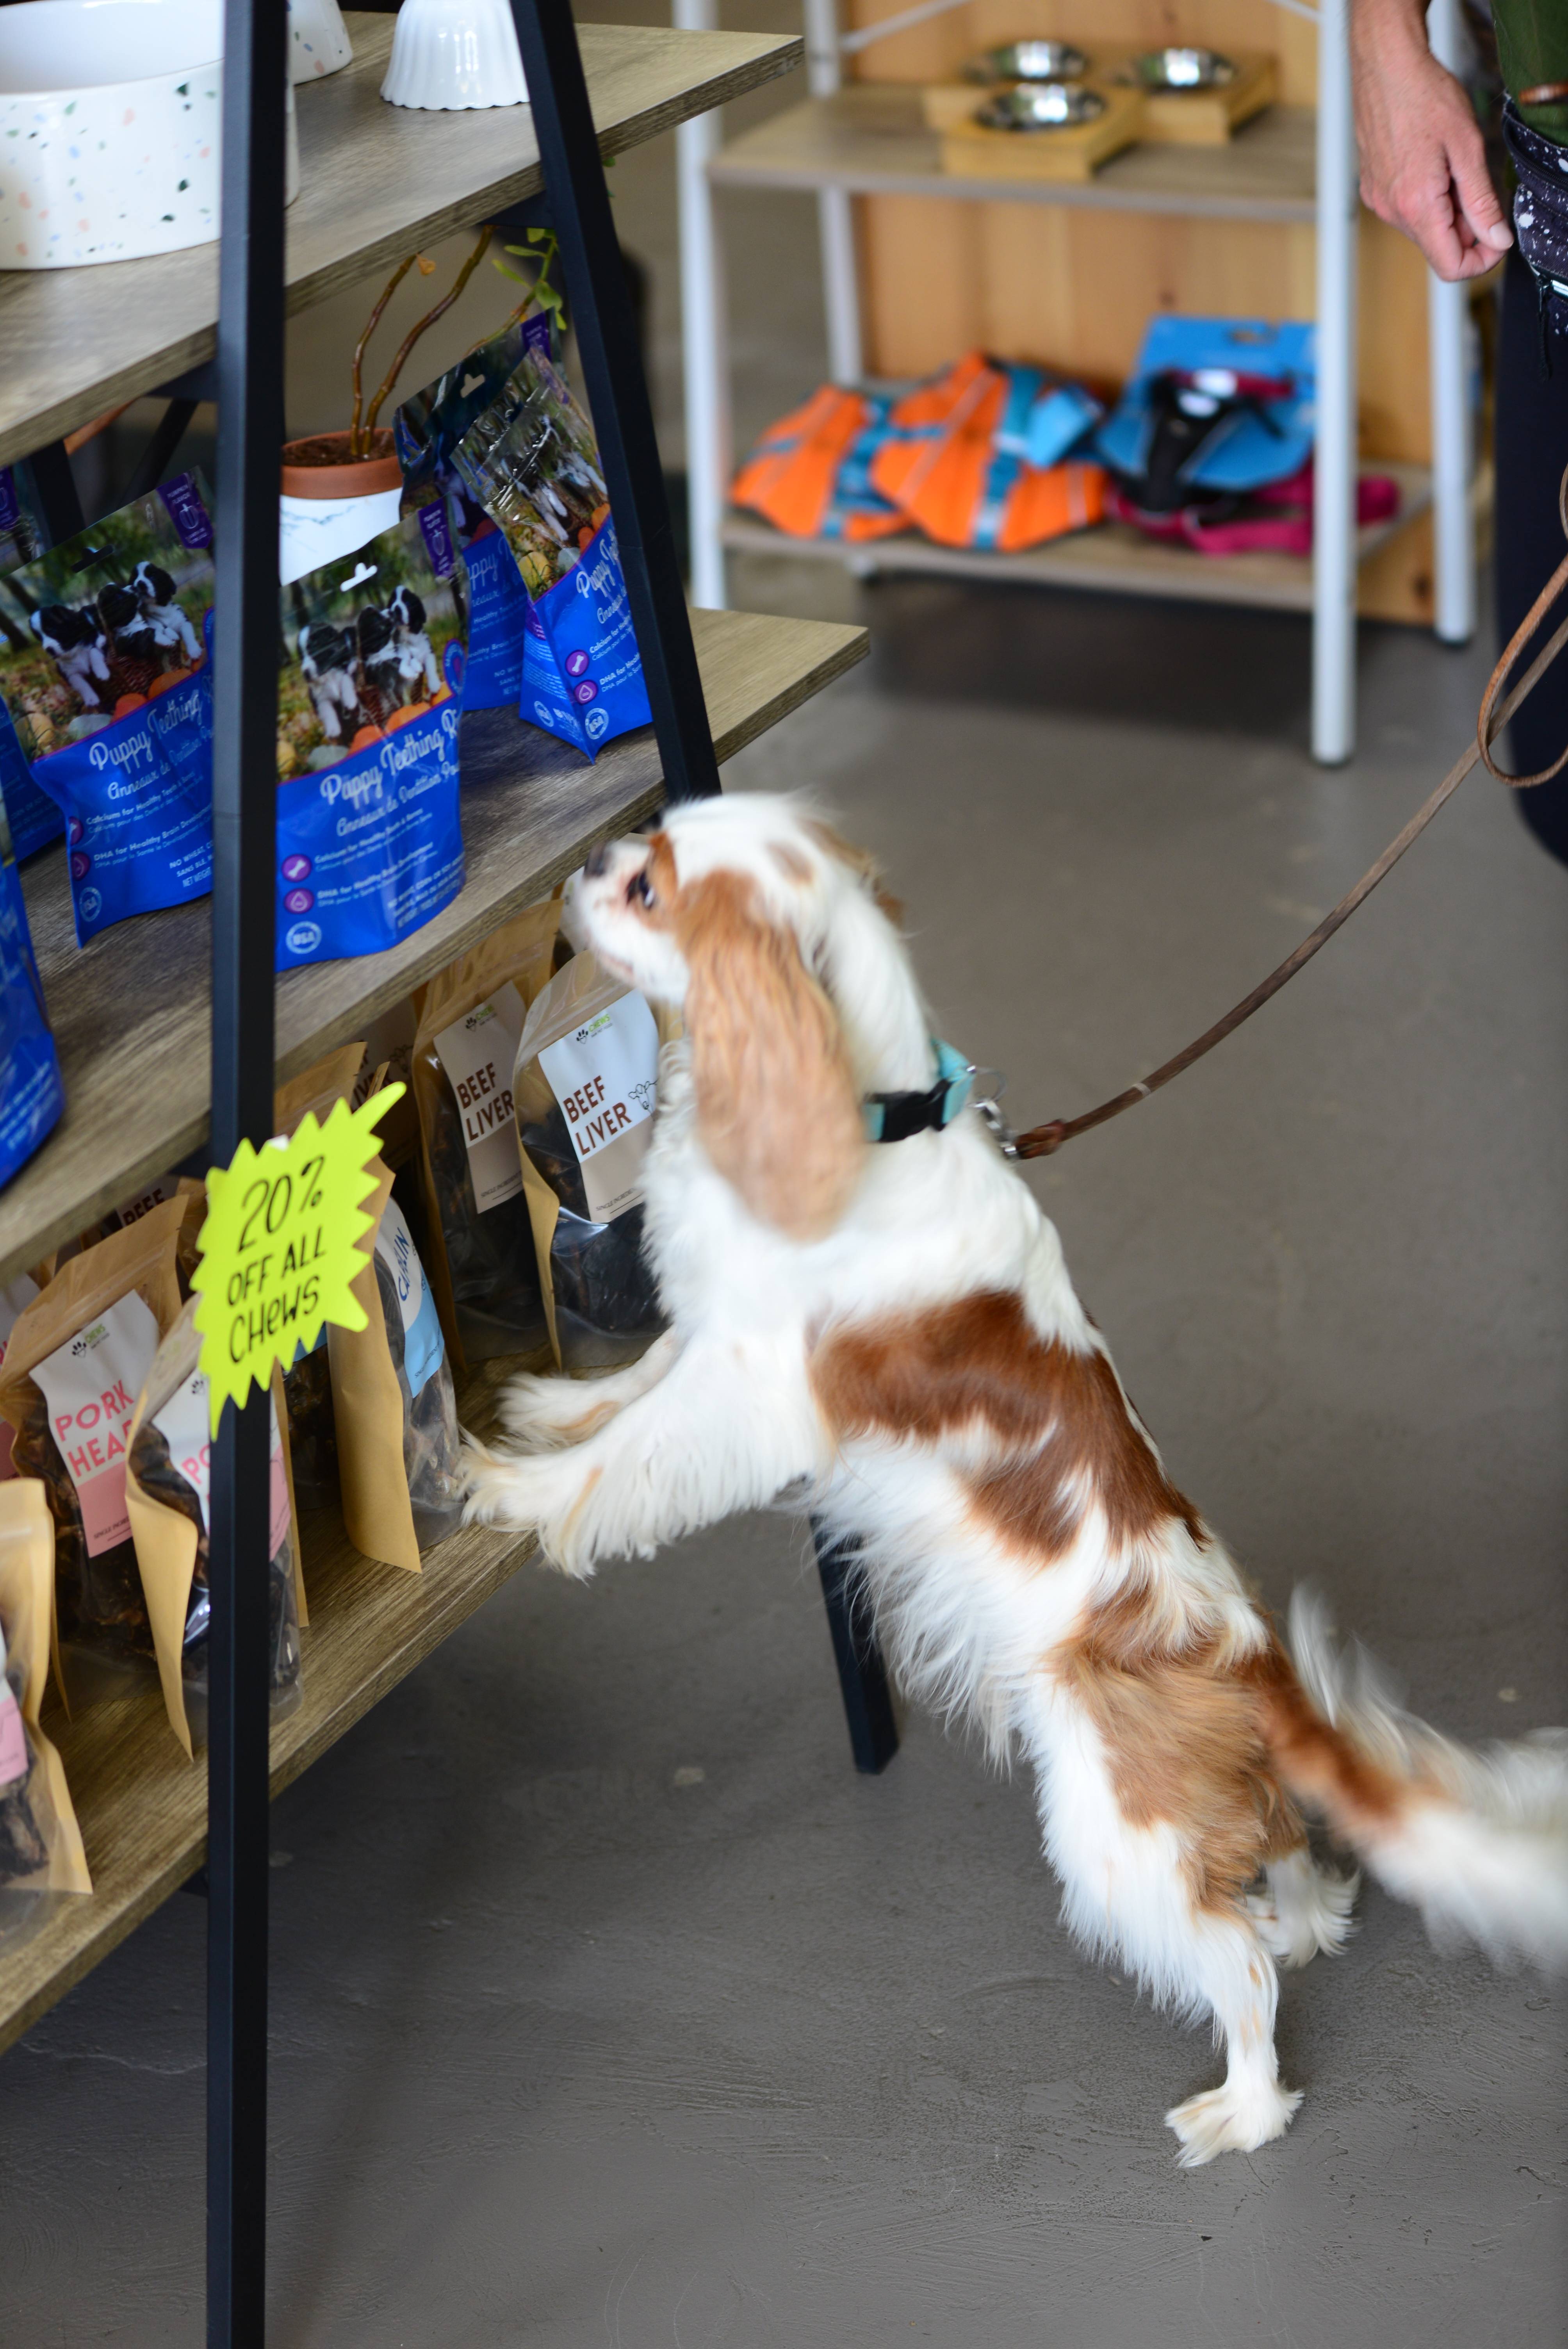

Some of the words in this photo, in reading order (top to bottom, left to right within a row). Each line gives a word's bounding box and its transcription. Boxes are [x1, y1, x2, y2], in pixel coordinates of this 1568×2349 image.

[89, 742, 154, 774] Puppy
[588, 1013, 611, 1032] CHEWS
[456, 1062, 496, 1109] BEEF
[563, 1075, 605, 1124] BEEF
[466, 1090, 515, 1141] LIVER
[575, 1102, 632, 1156] LIVER
[237, 1155, 324, 1255] 20%
[227, 1253, 273, 1307] OFF
[281, 1223, 326, 1279] ALL
[55, 1379, 135, 1442] PORK
